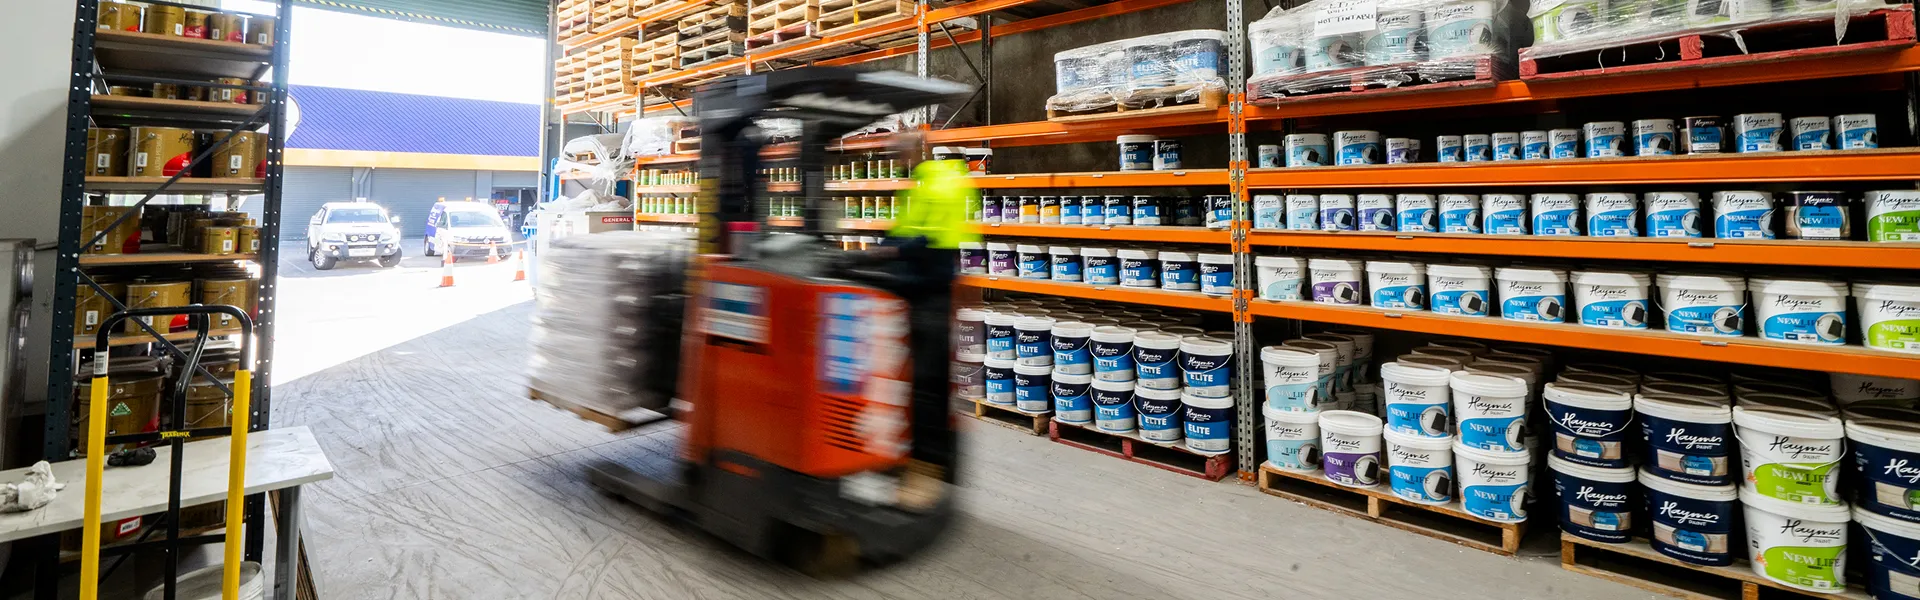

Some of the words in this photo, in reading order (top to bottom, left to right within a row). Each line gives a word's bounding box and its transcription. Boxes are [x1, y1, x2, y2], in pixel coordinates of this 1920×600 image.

[1744, 116, 1775, 127] Haymes
[1541, 196, 1572, 209] Haymes
[1597, 196, 1631, 209] Haymes
[1650, 195, 1687, 210] Haymes
[1724, 194, 1764, 209] Haymes
[1509, 281, 1542, 294] Haymes
[1590, 285, 1627, 299] Haymes
[1677, 289, 1718, 305] Haymes
[1775, 295, 1822, 311] Haymes
[990, 327, 1010, 337] Haymes
[1018, 332, 1039, 342] Haymes
[1055, 339, 1074, 348] Haymes
[1096, 344, 1118, 356] Haymes
[1138, 350, 1162, 362] Haymes
[1188, 356, 1214, 369] Haymes
[1098, 360, 1118, 368] ELITE
[1140, 366, 1161, 374] ELITE
[1190, 374, 1213, 382] ELITE
[1275, 367, 1308, 382] Haymes
[987, 382, 1002, 390] ELITE
[1016, 388, 1029, 397] ELITE
[1055, 385, 1074, 395] Haymes
[1390, 383, 1426, 401] Haymes
[1097, 392, 1120, 404] Haymes
[1099, 408, 1120, 416] ELITE
[1142, 401, 1168, 412] Haymes
[1468, 396, 1512, 415] Haymes
[1186, 408, 1211, 421] Haymes
[1145, 418, 1167, 426] ELITE
[1562, 413, 1613, 434] Haymes
[1188, 424, 1210, 435] ELITE
[1270, 421, 1302, 437] Haymes
[1326, 432, 1360, 449] Haymes
[1666, 428, 1722, 449] Haymes
[1770, 436, 1830, 459] Haymes
[1393, 445, 1429, 464] Haymes
[1473, 463, 1516, 483] Haymes
[1577, 486, 1626, 507] Haymes
[1660, 501, 1719, 525] Haymes
[1781, 519, 1841, 543] Haymes
